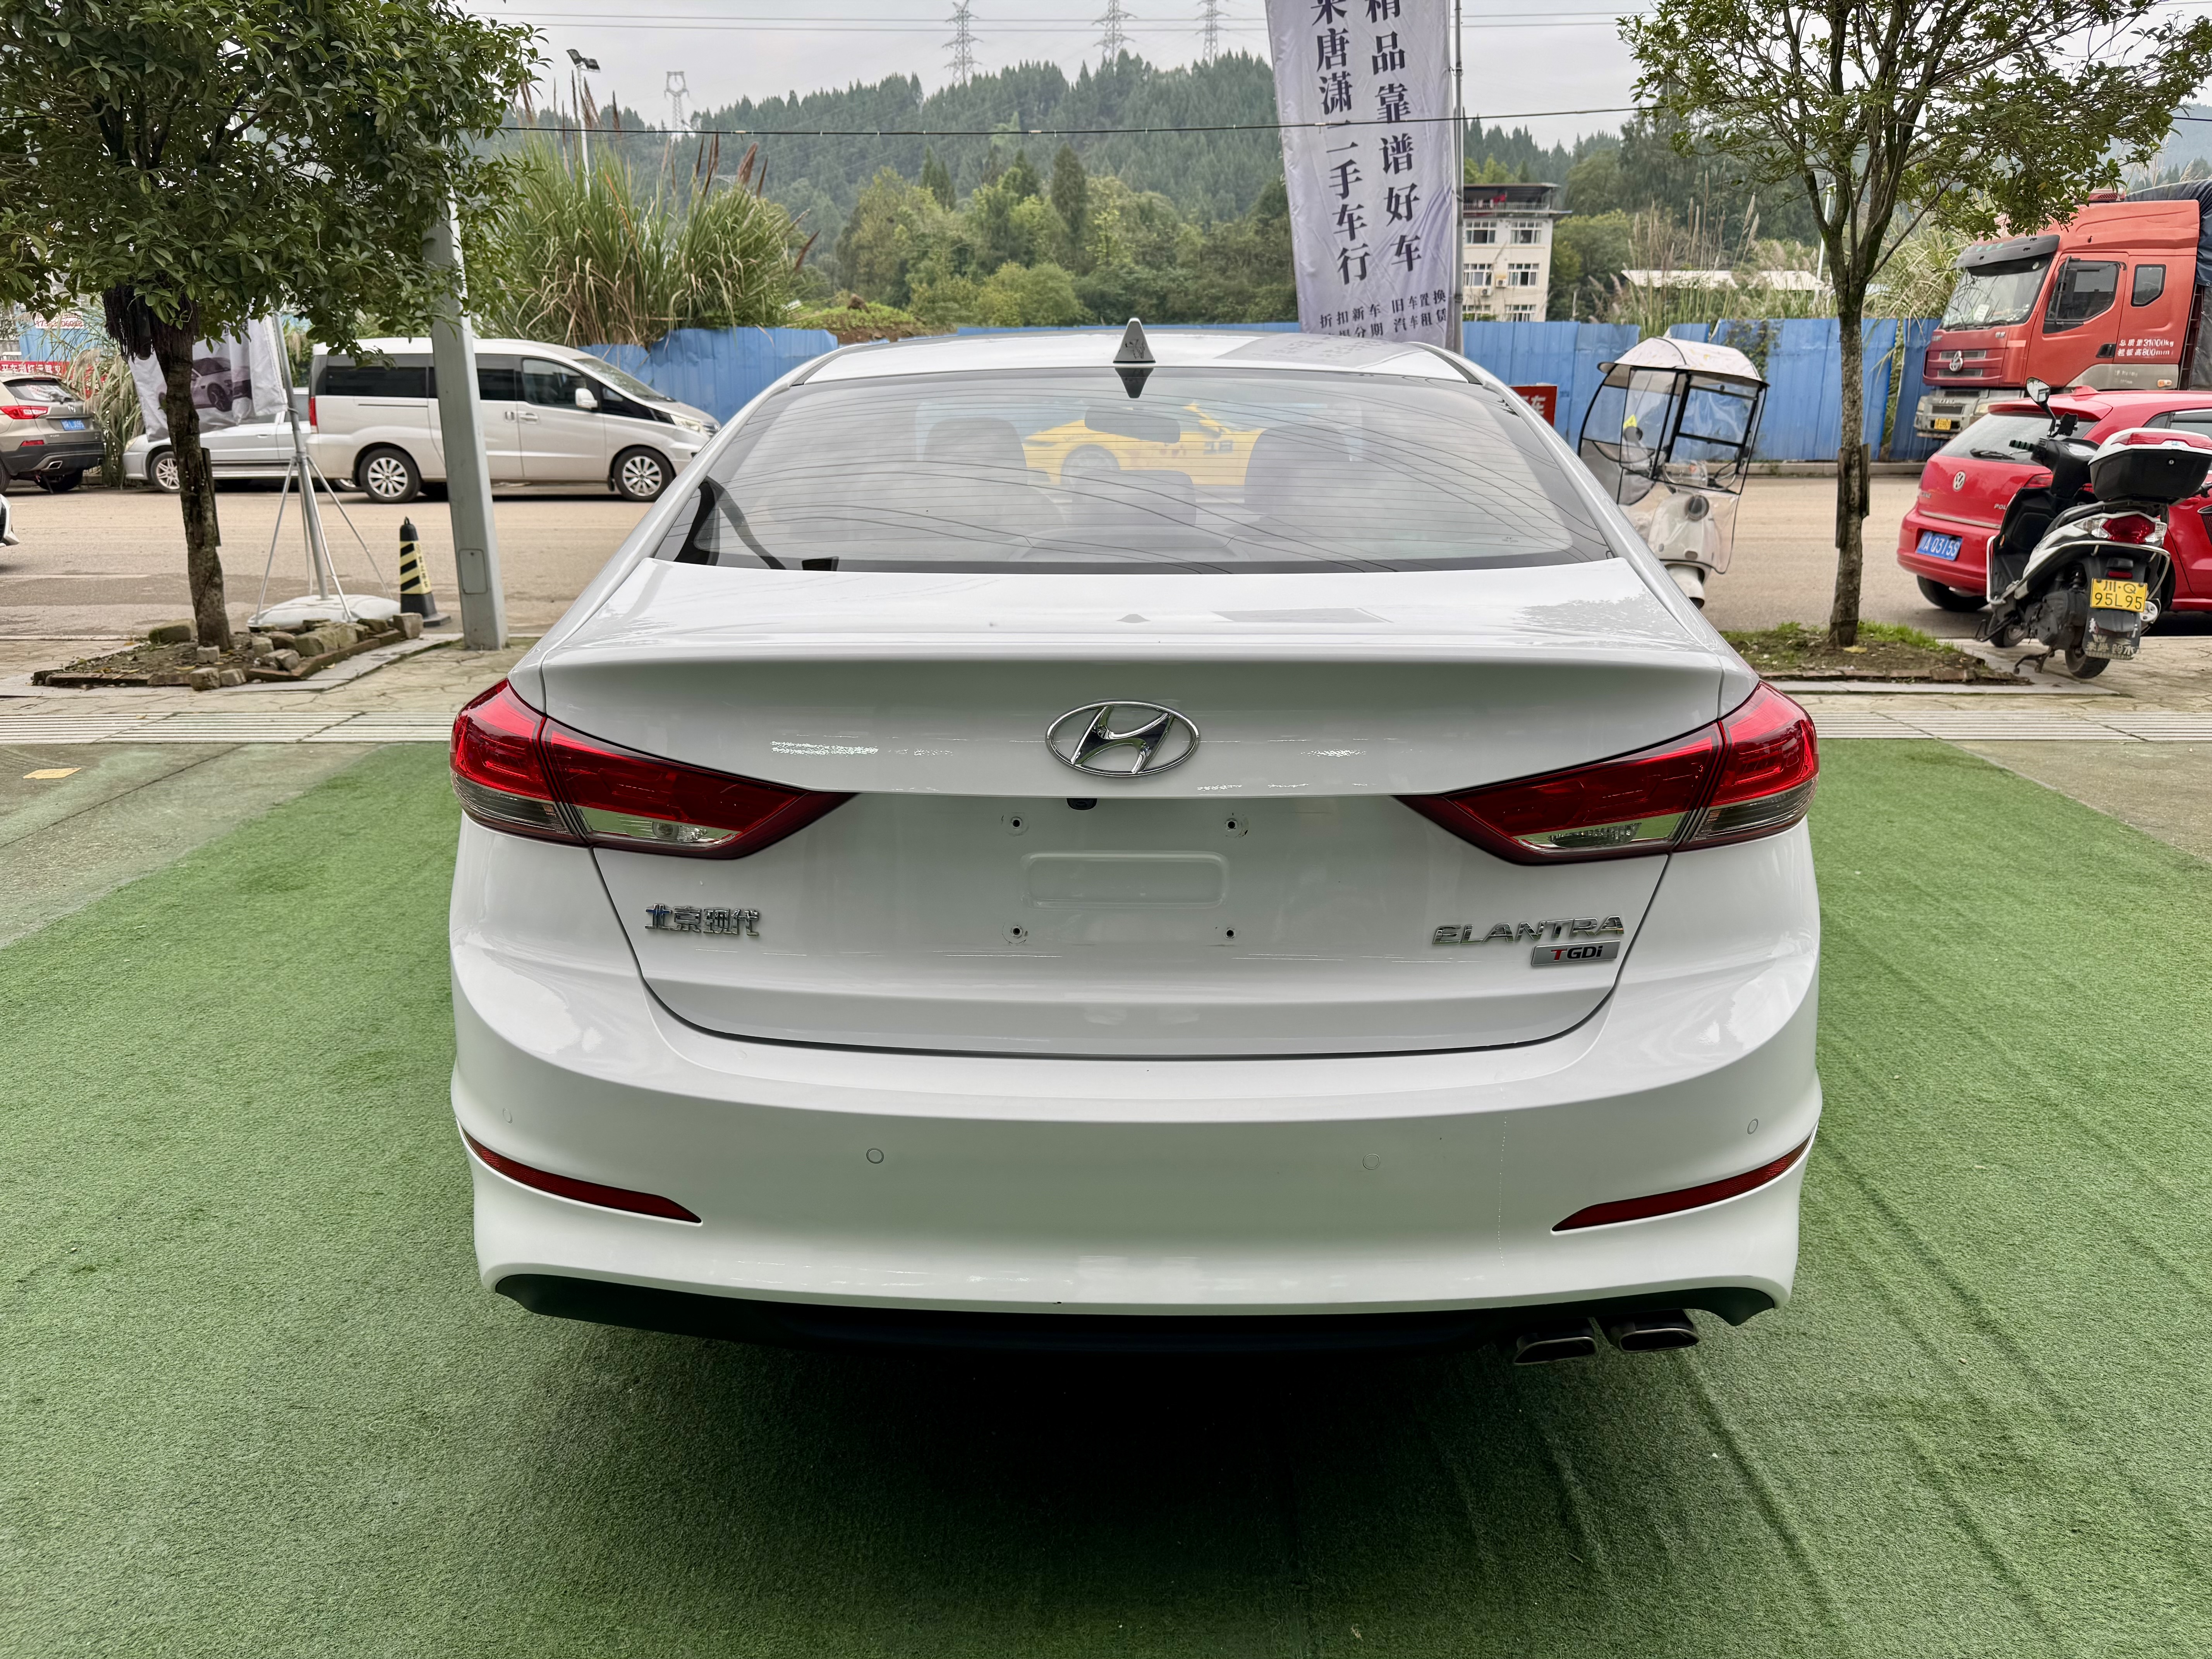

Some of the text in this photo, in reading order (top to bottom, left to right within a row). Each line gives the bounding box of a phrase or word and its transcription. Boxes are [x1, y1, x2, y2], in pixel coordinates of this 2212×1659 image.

[1320, 289, 1446, 329] 折扣新车 旧车置换
[1328, 308, 1447, 338] 分期 汽车租赁
[2095, 592, 2143, 610] 95L95
[644, 903, 759, 936] 北京现代
[1432, 915, 1625, 945] ELANTRA
[1550, 945, 1604, 961] TGDi
